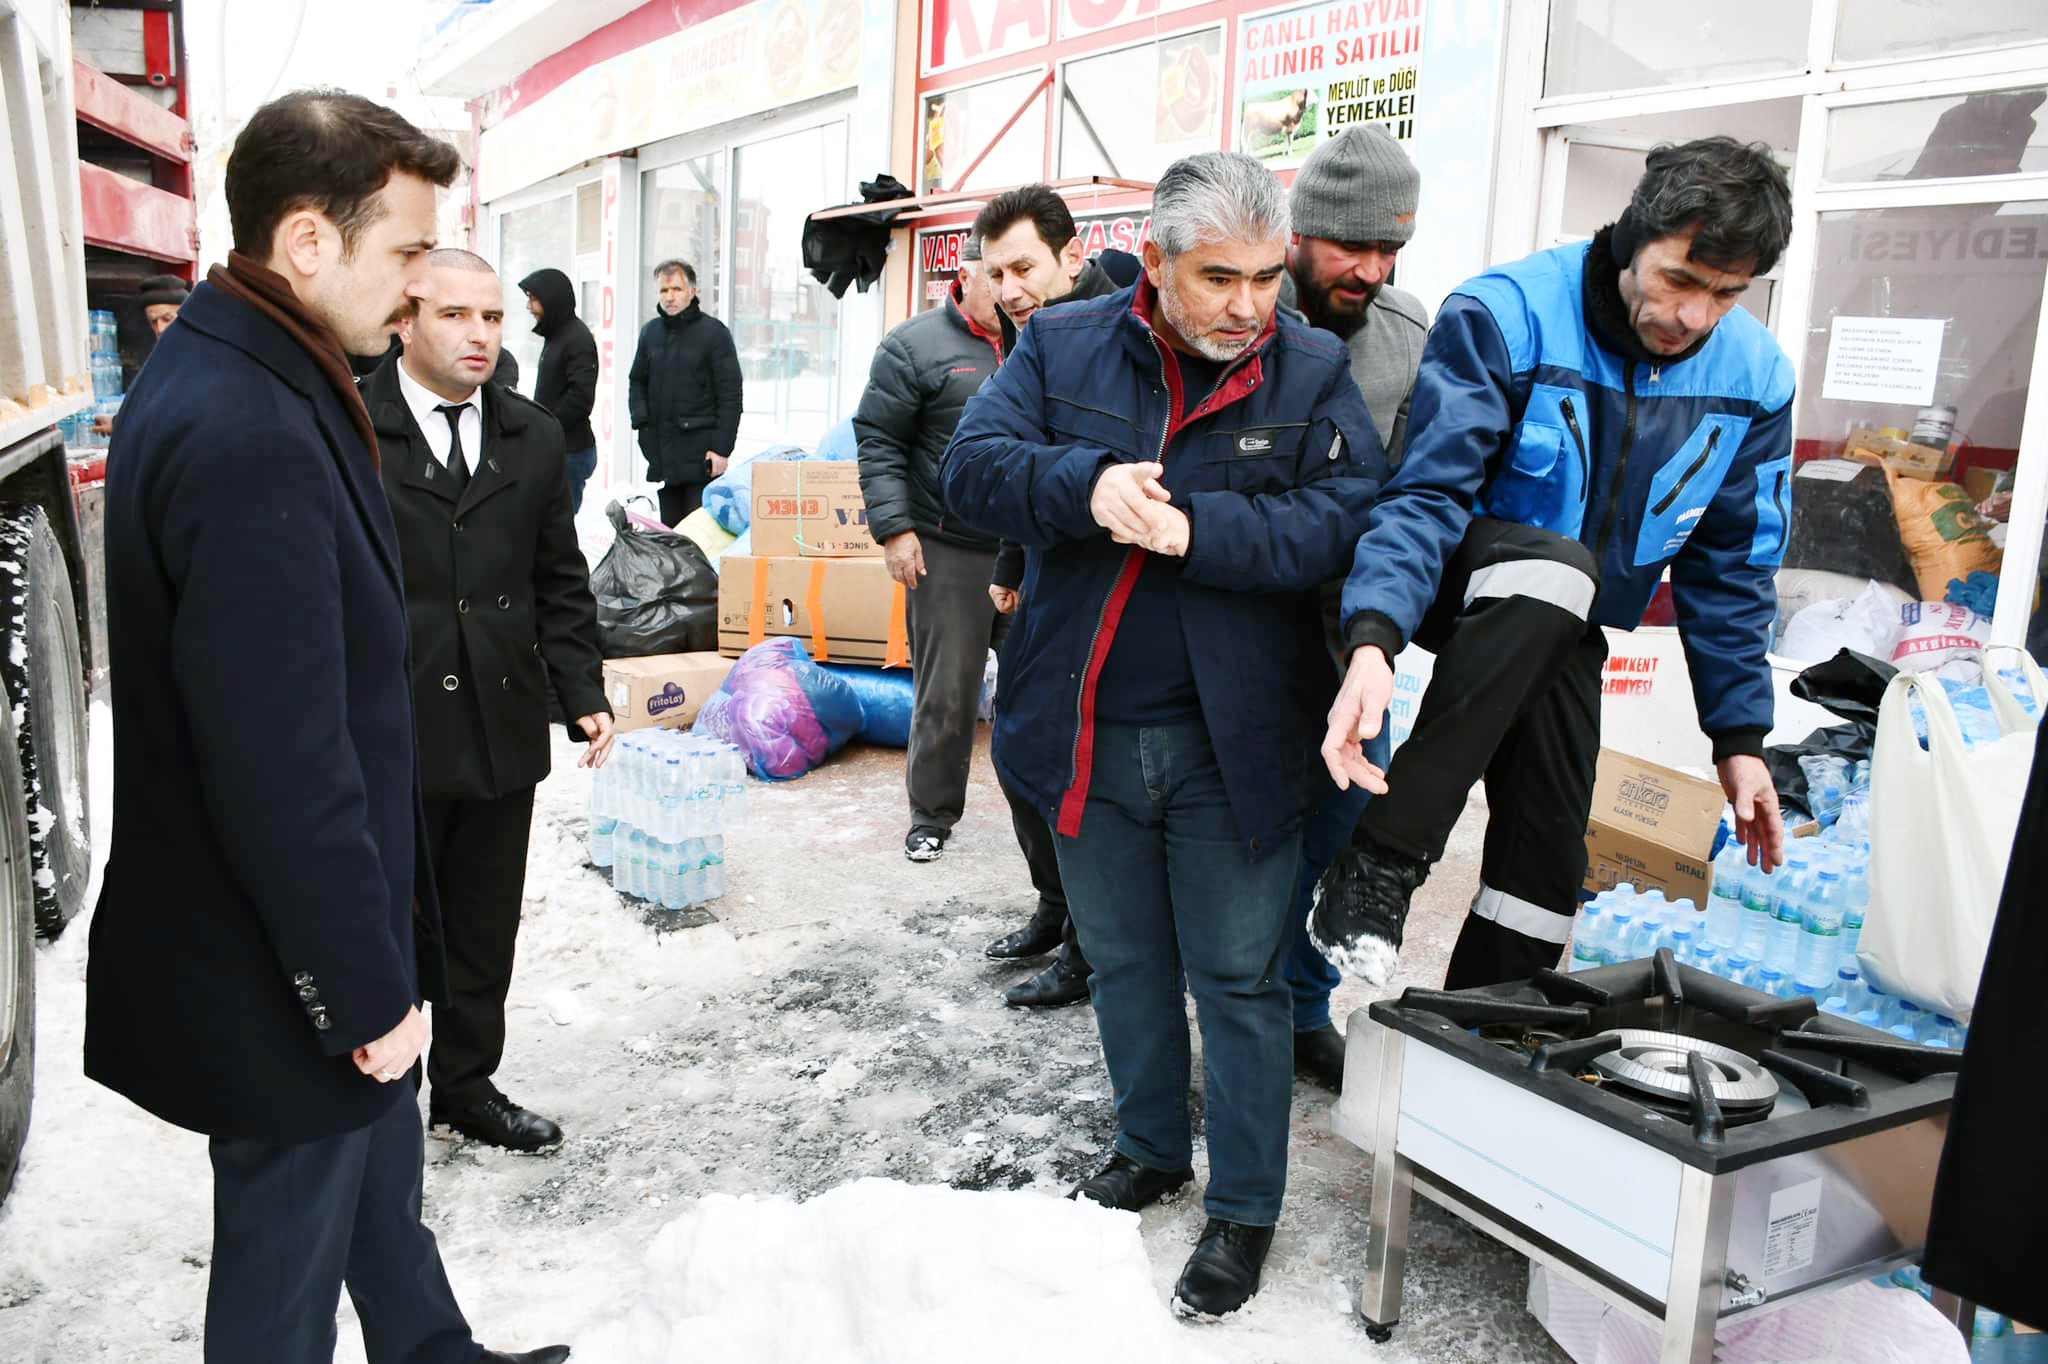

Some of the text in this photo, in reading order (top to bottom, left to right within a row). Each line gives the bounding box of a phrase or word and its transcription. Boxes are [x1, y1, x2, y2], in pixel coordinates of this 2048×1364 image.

[1246, 14, 1316, 51] CANLI
[1245, 44, 1325, 83] ALINIR
[1328, 75, 1370, 103] MEVLÜT
[1373, 78, 1385, 96] ve
